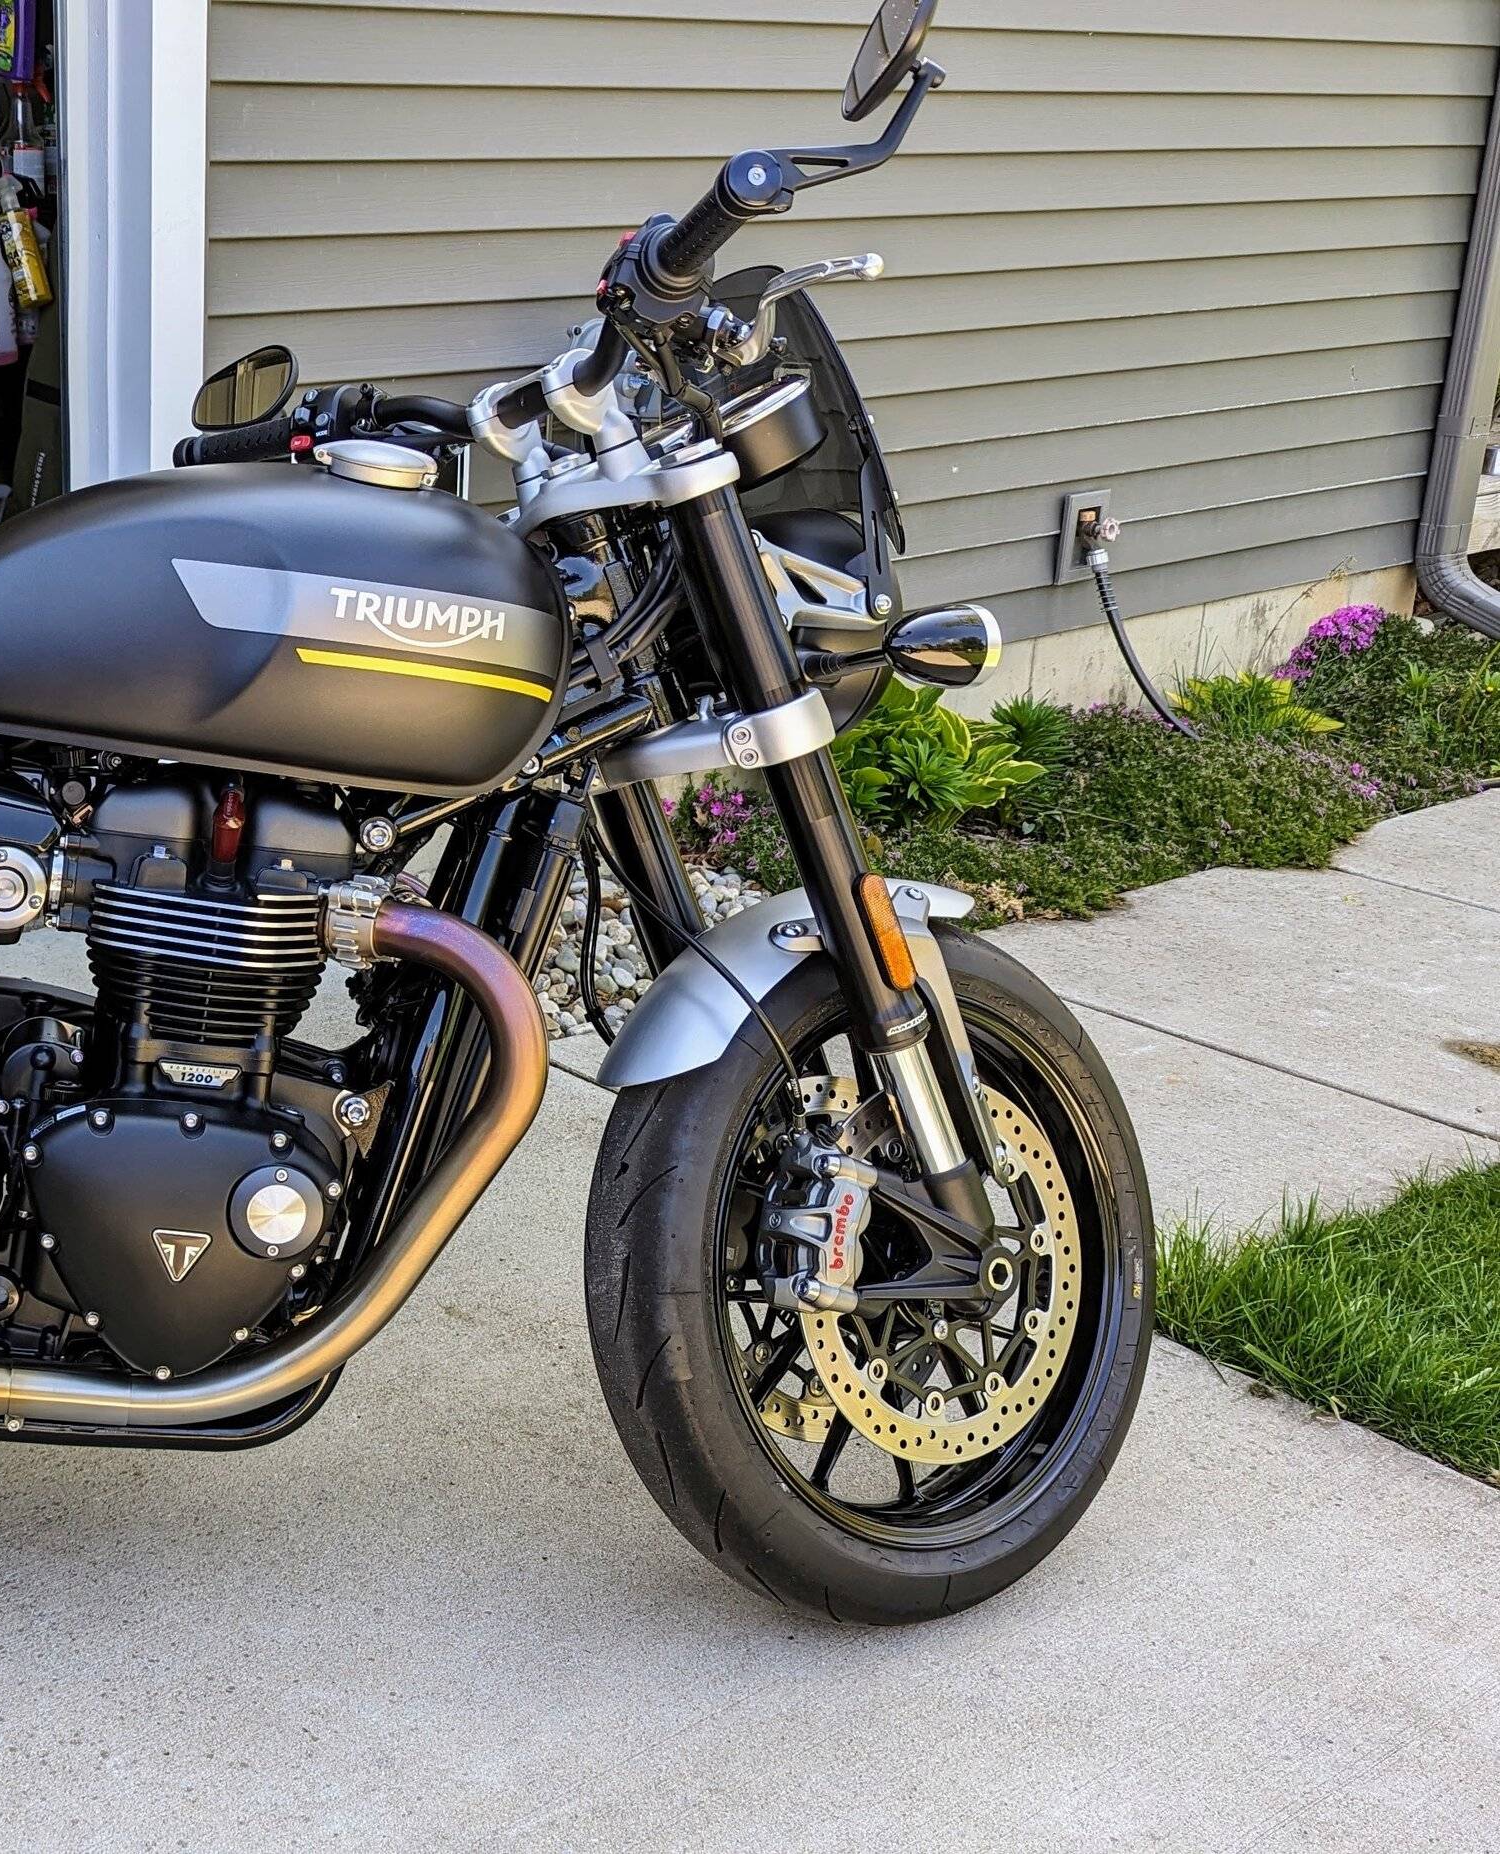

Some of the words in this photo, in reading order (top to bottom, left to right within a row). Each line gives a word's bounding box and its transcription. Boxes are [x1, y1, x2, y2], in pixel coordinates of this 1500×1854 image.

[329, 587, 506, 648] TRIUMPH
[181, 1072, 213, 1084] 1200
[829, 1193, 854, 1270] brembo
